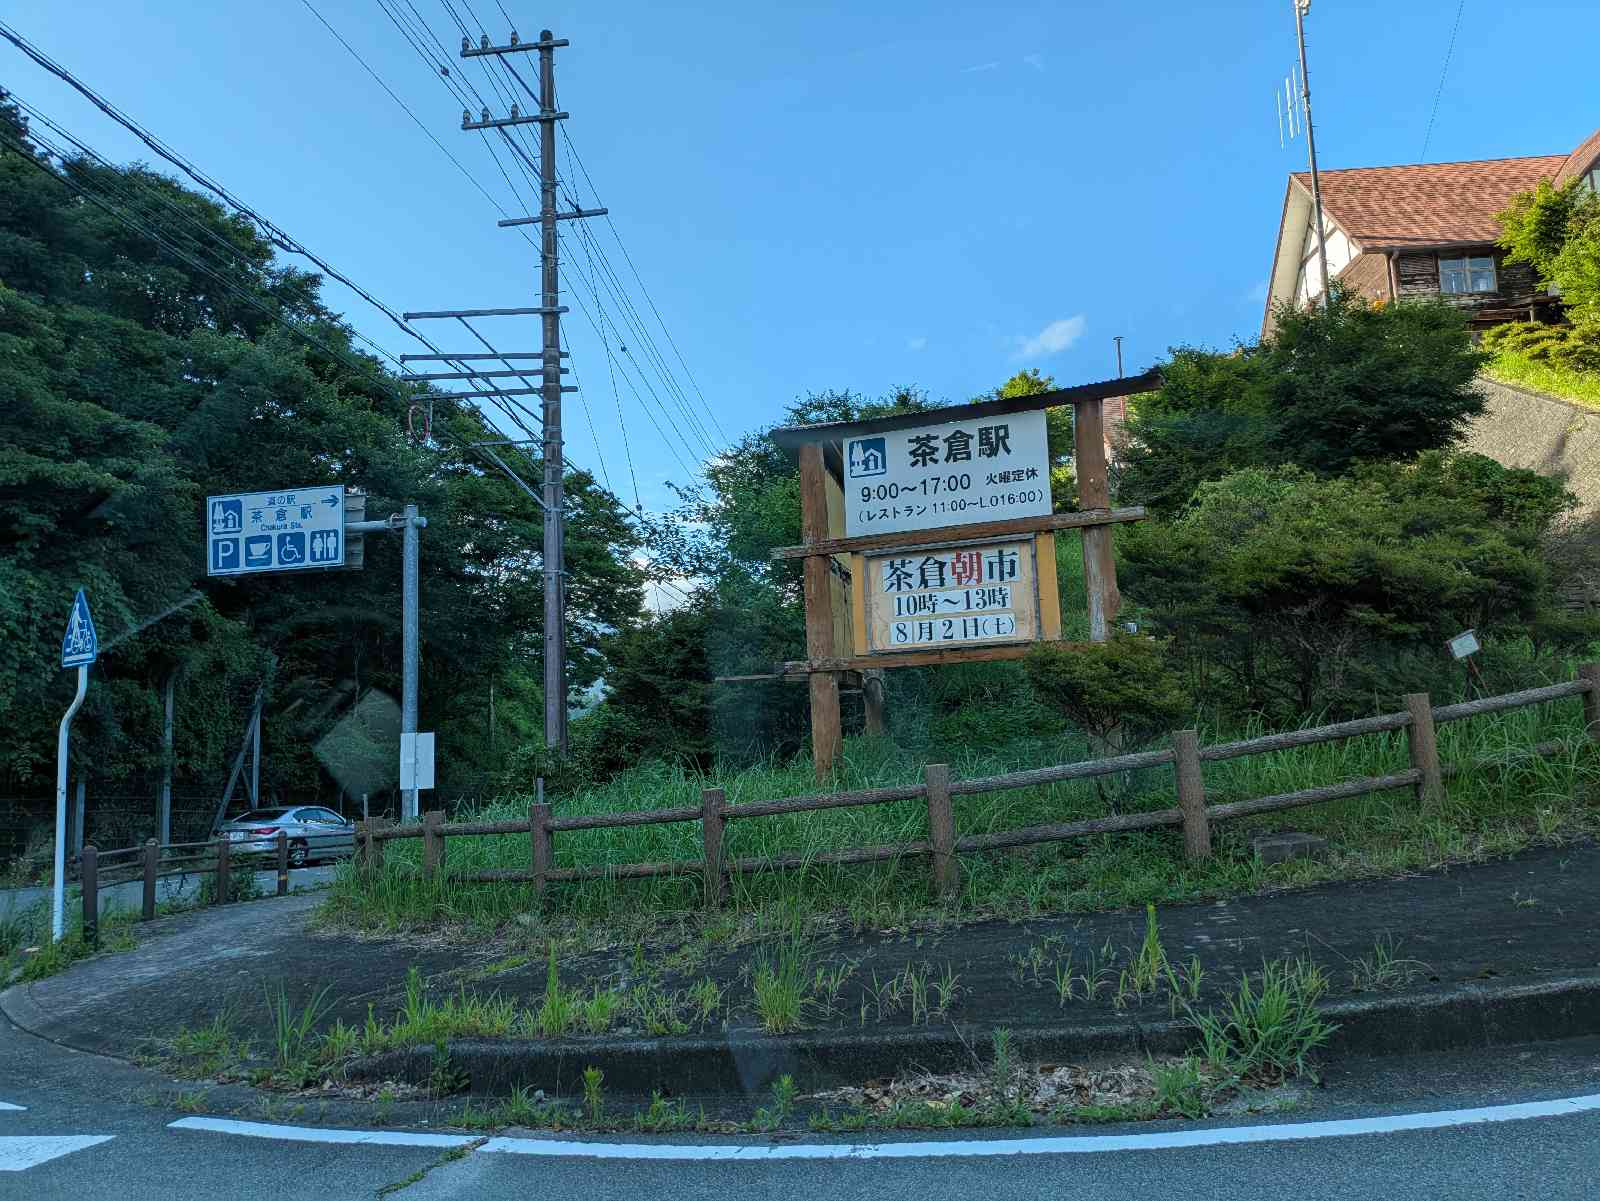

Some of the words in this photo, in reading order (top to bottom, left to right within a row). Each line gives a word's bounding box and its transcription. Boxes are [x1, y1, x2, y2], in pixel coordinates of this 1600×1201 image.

[908, 424, 1012, 468] 茶倉駅
[986, 467, 1039, 486] 火曜定休
[218, 541, 234, 568] P
[884, 549, 1018, 593] 茶倉朝市
